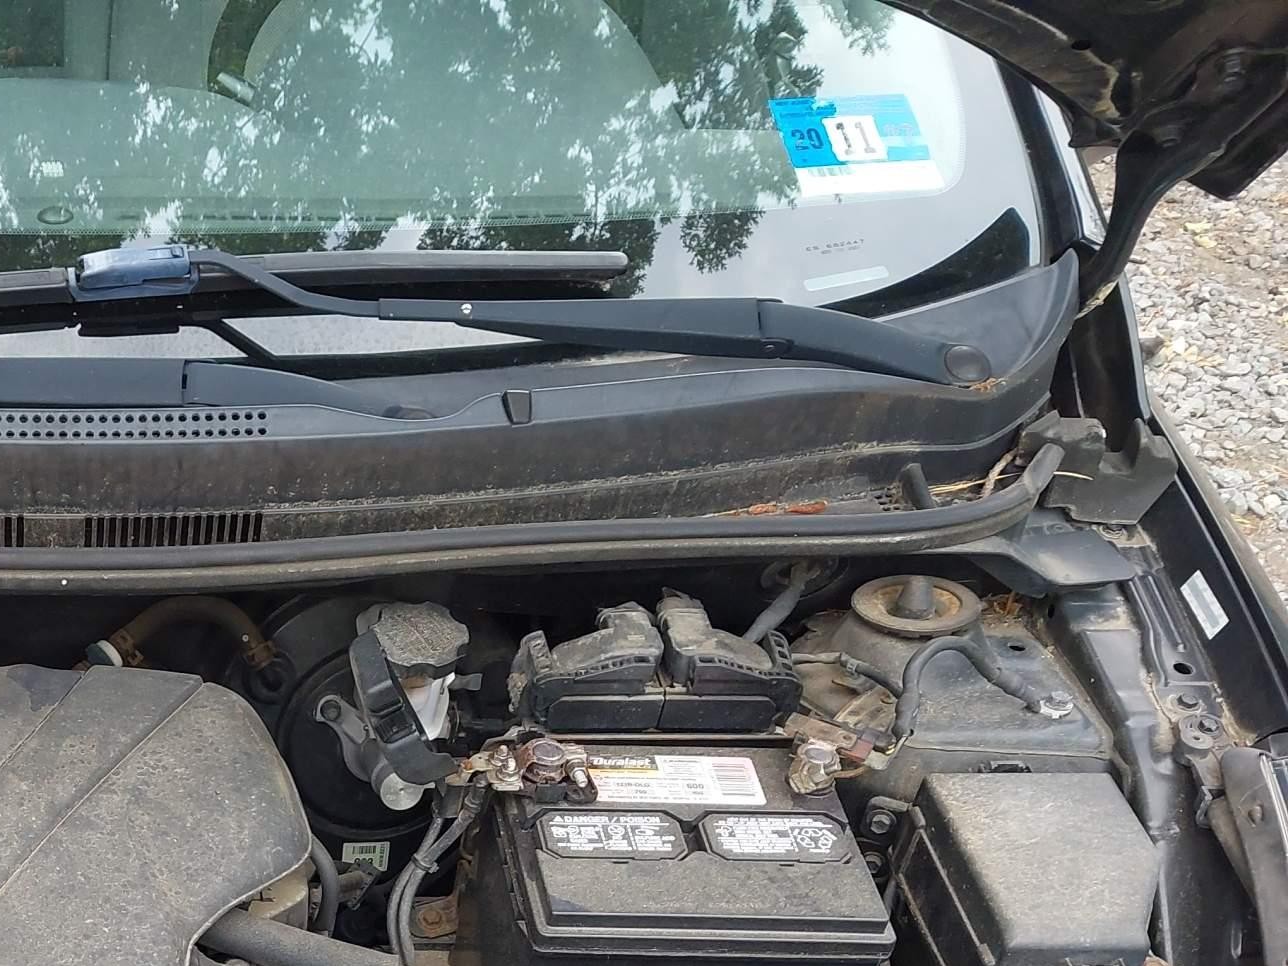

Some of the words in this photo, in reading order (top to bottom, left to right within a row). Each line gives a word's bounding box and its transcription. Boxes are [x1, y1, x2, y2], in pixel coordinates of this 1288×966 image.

[836, 121, 877, 156] 11
[591, 757, 651, 767] Duralast
[564, 815, 609, 823] DANGER
[619, 816, 660, 824] POISON
